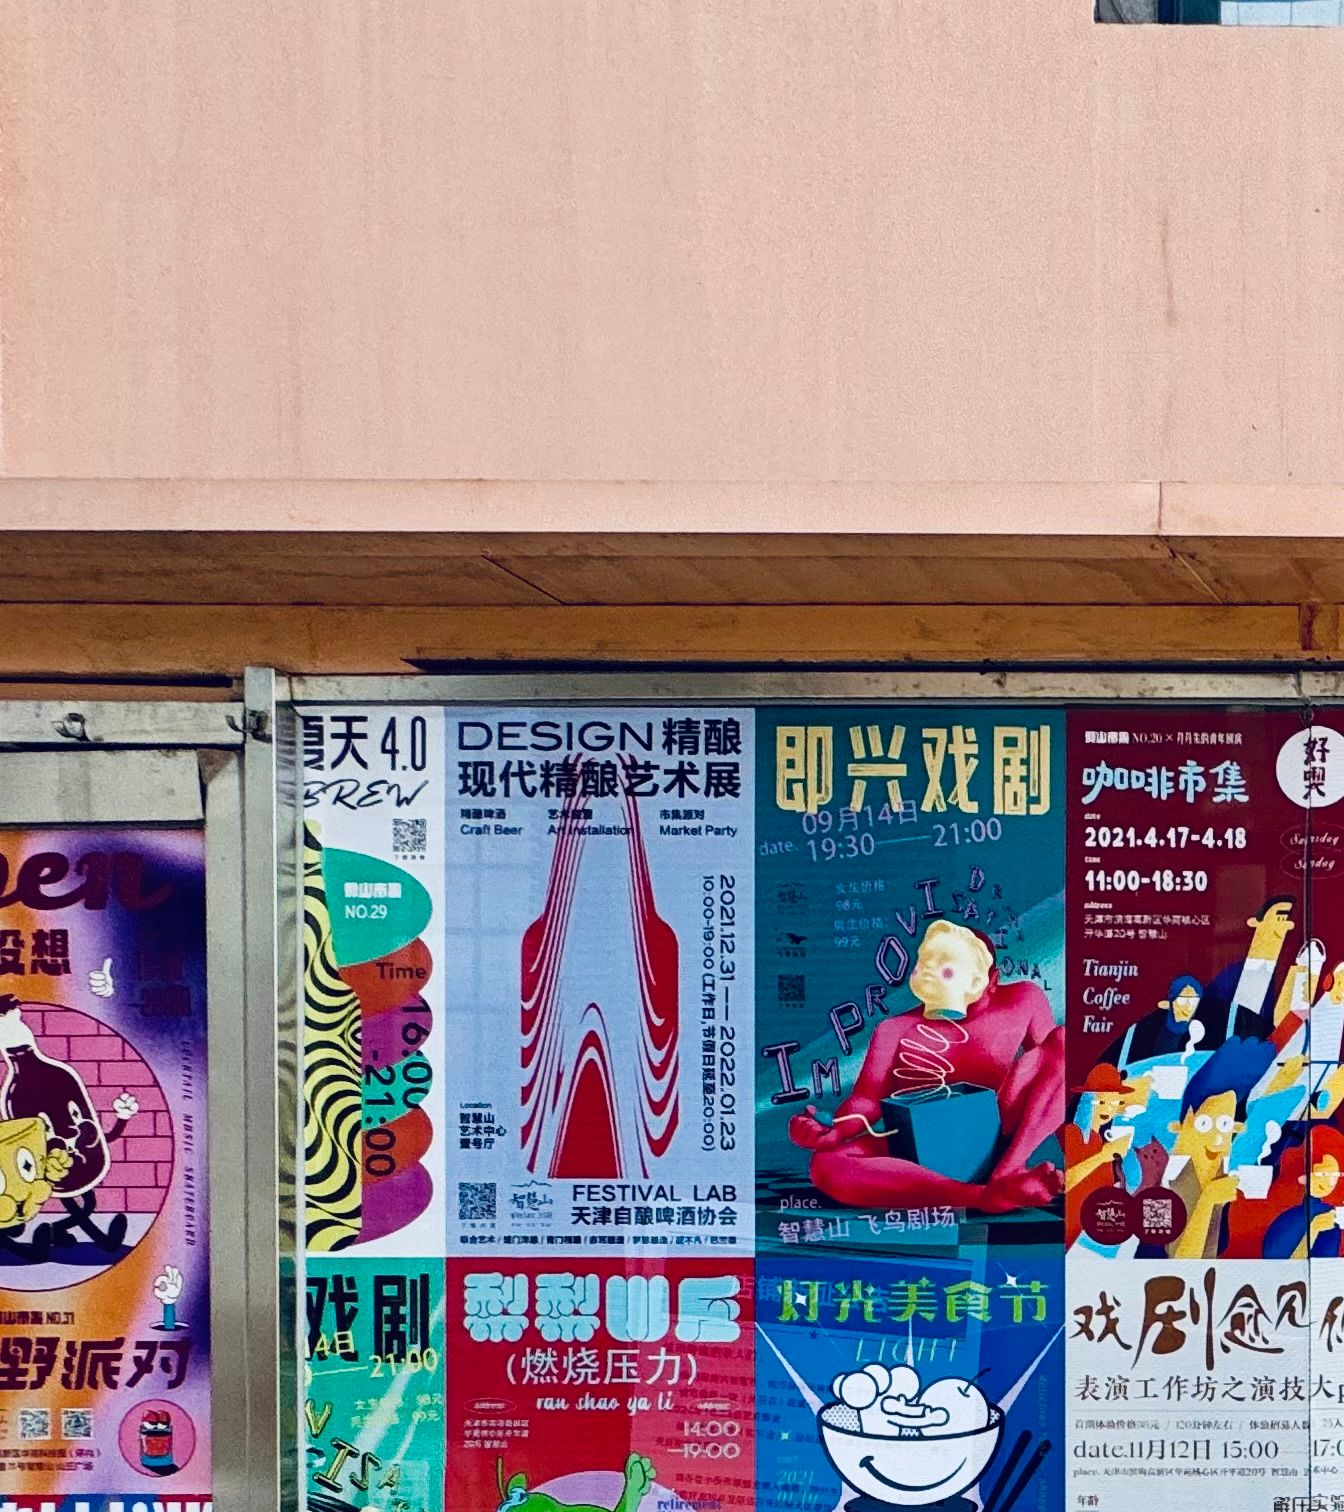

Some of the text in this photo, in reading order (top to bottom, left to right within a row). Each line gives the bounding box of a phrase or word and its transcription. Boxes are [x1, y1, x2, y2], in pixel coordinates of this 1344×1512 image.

[458, 718, 741, 756] DESIGN 精酿
[458, 761, 741, 799] 现代精酿艺术展
[775, 725, 1050, 816] 即兴戏剧
[1082, 760, 1249, 803] 咖啡市集
[660, 825, 737, 837] Market Party
[1085, 827, 1246, 849] 2021.4.17-4.18
[1085, 870, 1208, 892] 11:00-18:30
[345, 905, 387, 920] NO.29
[377, 963, 426, 980] Time
[1084, 958, 1138, 979] Tianjin
[1084, 988, 1130, 1007] Coffee
[1084, 1016, 1113, 1035] Fair
[573, 1185, 737, 1202] FESTIVAL LAB
[779, 1195, 822, 1211] place.
[571, 1207, 737, 1227] 天津自酿啤酒协会
[777, 1279, 1048, 1323] 灯光美食节
[683, 1421, 741, 1437] 14:00
[1223, 1440, 1278, 1459] 15:00
